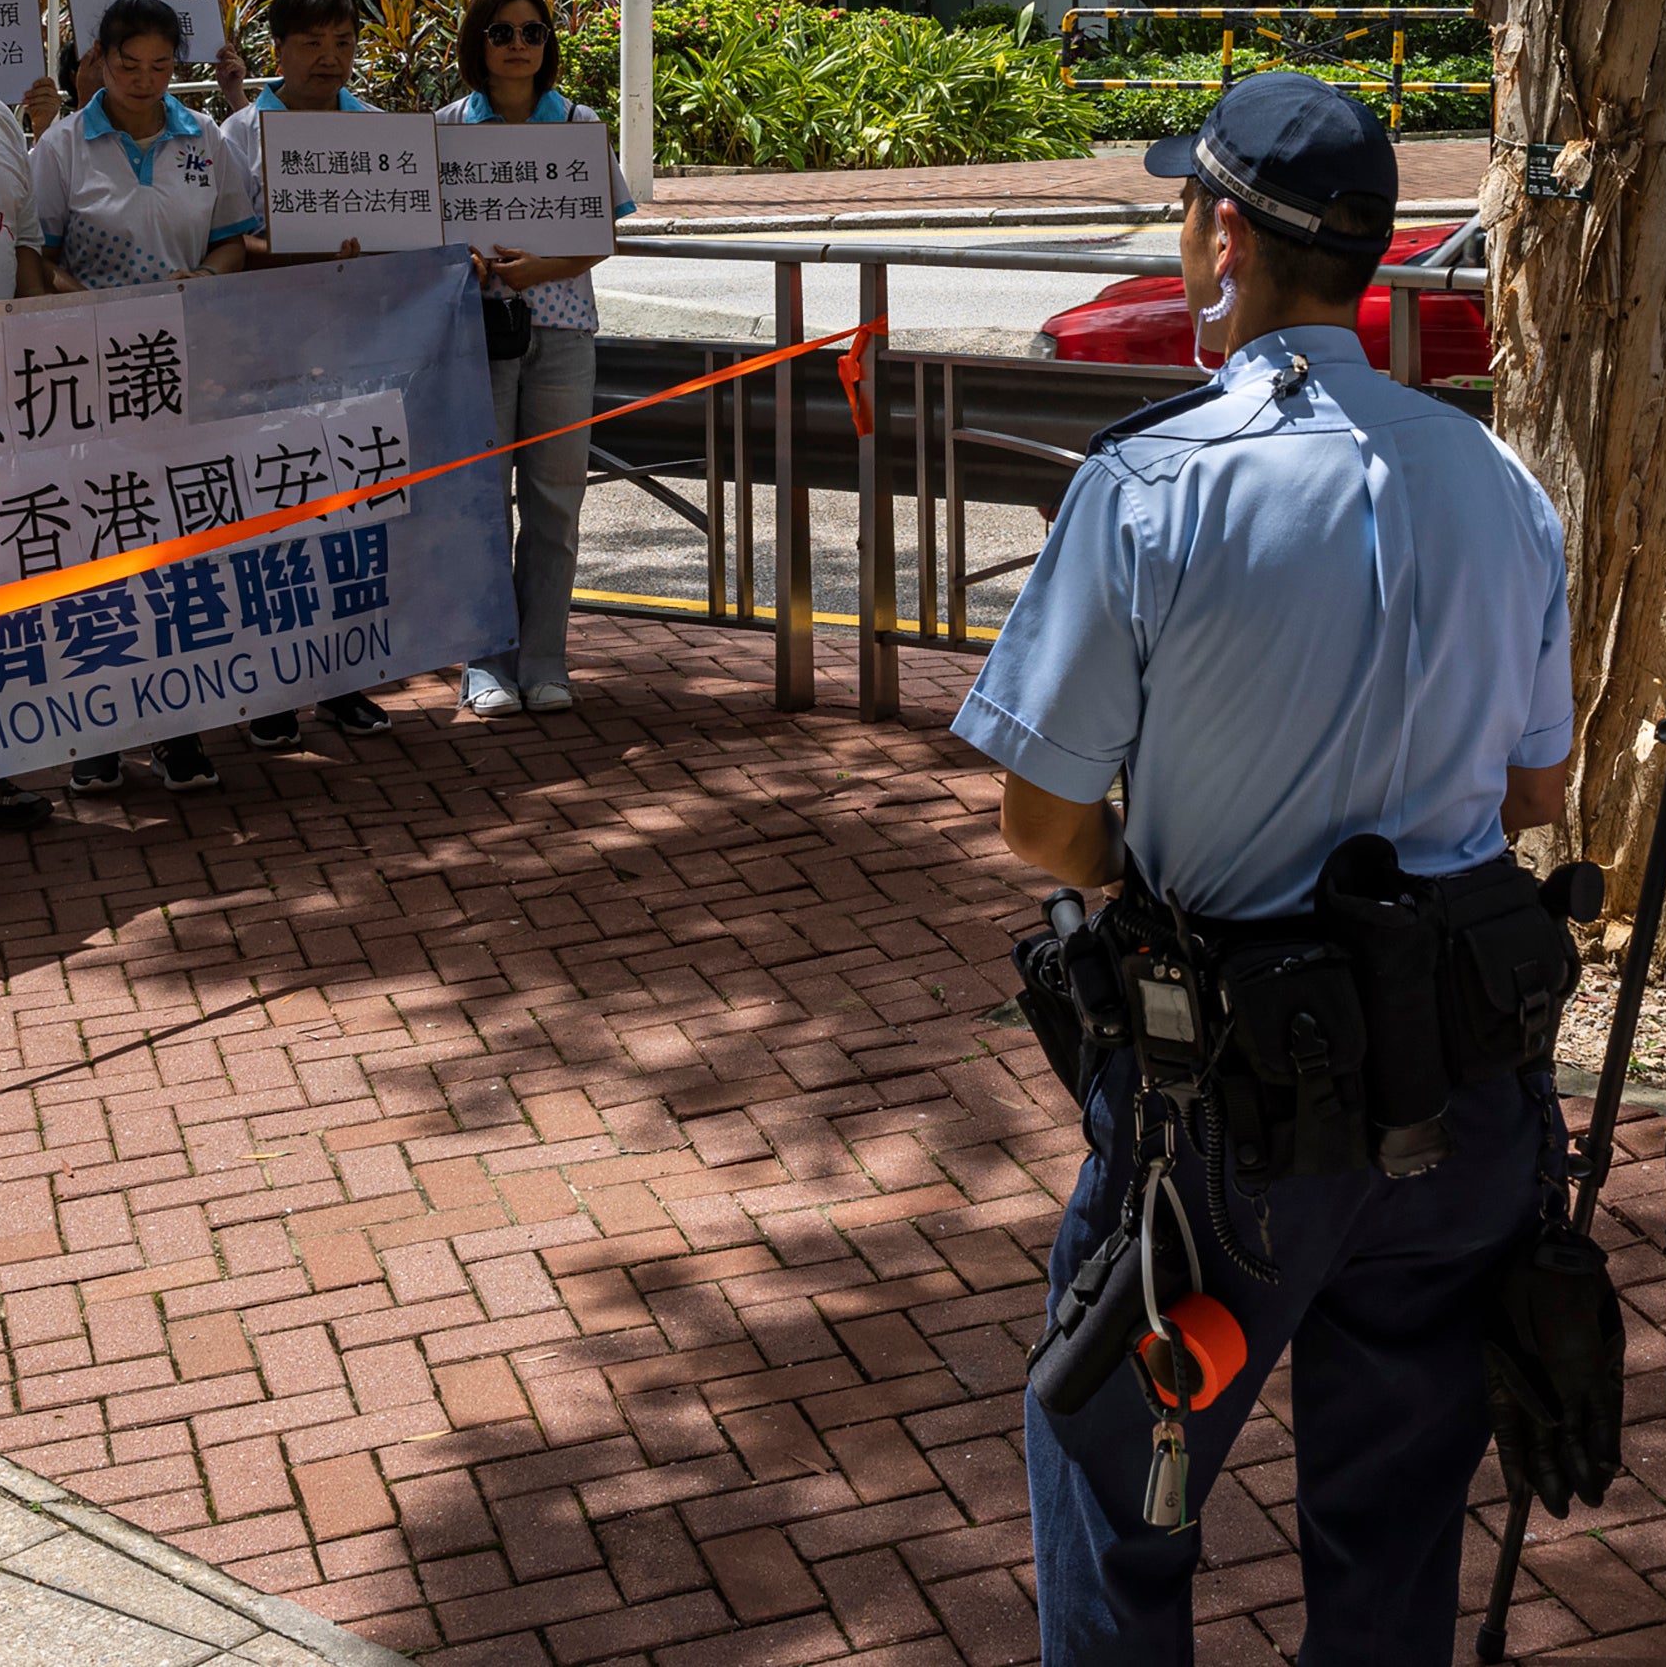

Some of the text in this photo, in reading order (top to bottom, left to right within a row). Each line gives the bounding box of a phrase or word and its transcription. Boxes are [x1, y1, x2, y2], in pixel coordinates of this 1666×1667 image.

[280, 150, 418, 176] 懸紅通緝 8 名
[439, 159, 590, 186] 懸紅通緝 8 名
[271, 188, 432, 214] 逃港者合法有理
[1226, 175, 1266, 207] POLICE
[131, 652, 259, 720] KONG
[271, 618, 392, 686] UNION
